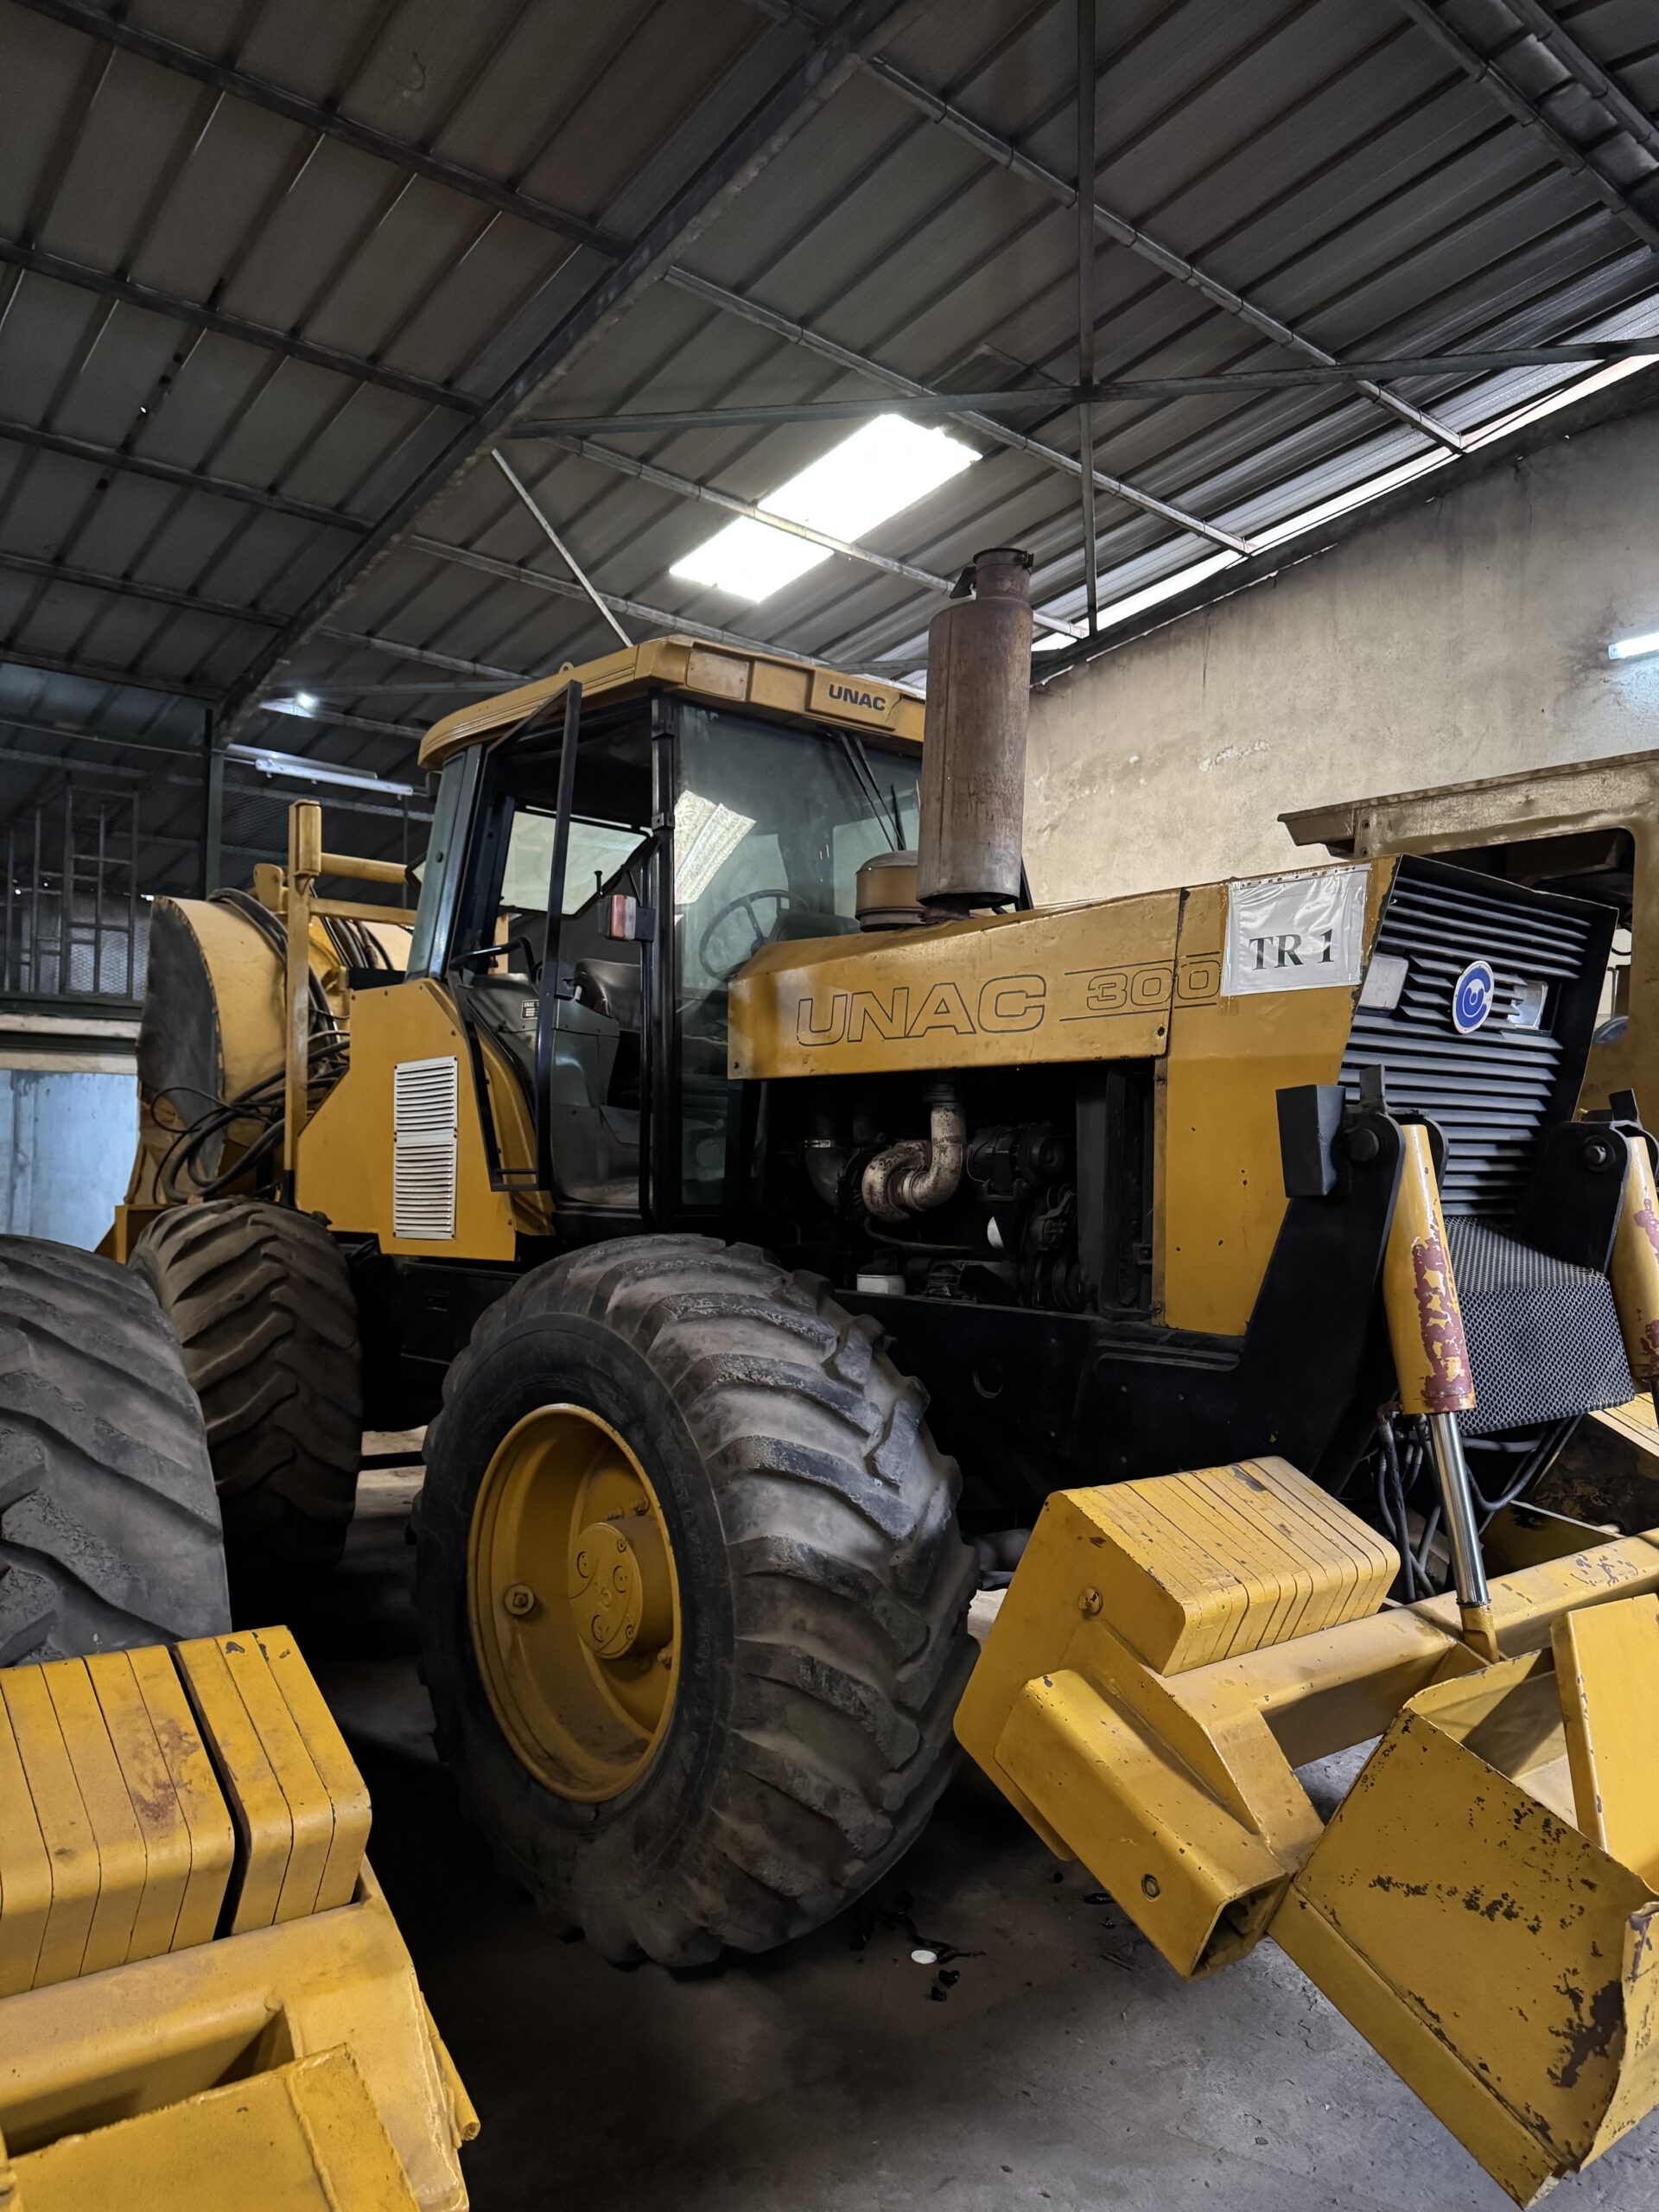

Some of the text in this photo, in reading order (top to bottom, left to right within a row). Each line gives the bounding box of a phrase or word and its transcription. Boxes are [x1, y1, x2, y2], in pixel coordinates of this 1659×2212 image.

[829, 683, 886, 711] UNAC
[1249, 929, 1334, 970] TR 1
[796, 960, 1221, 1046] UNAC 300
